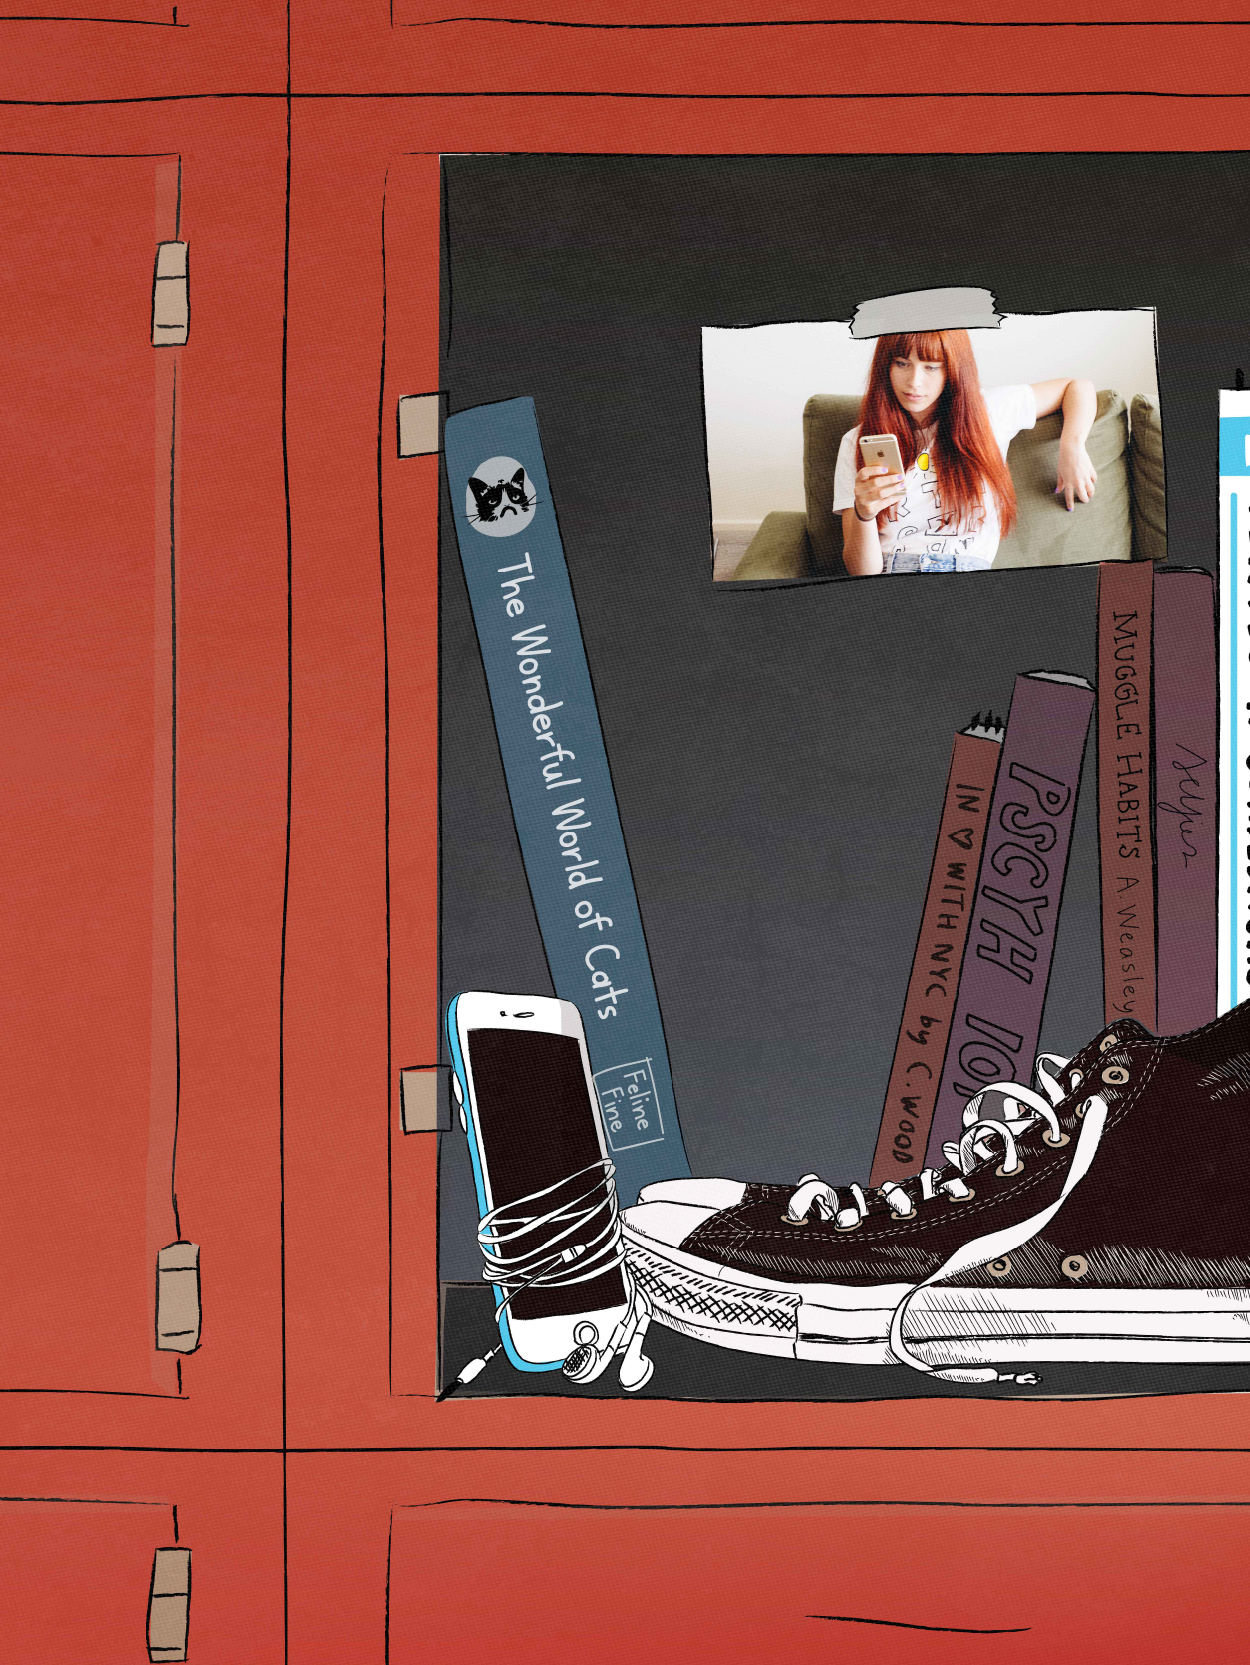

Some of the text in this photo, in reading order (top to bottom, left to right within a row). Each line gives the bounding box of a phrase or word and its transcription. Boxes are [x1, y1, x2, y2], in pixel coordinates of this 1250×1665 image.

[1112, 609, 1143, 741] MUGGLE
[497, 551, 629, 1021] The Wonderful World of Cats
[955, 783, 986, 814] IN
[1115, 751, 1144, 859] HABITS
[936, 861, 968, 930] WITH
[976, 761, 1072, 985] PSCYH
[925, 943, 955, 998] NYC
[905, 1013, 943, 1046] by
[601, 1086, 625, 1134] Fine
[623, 1068, 651, 1132] Feline
[892, 1095, 922, 1164] WOOD
